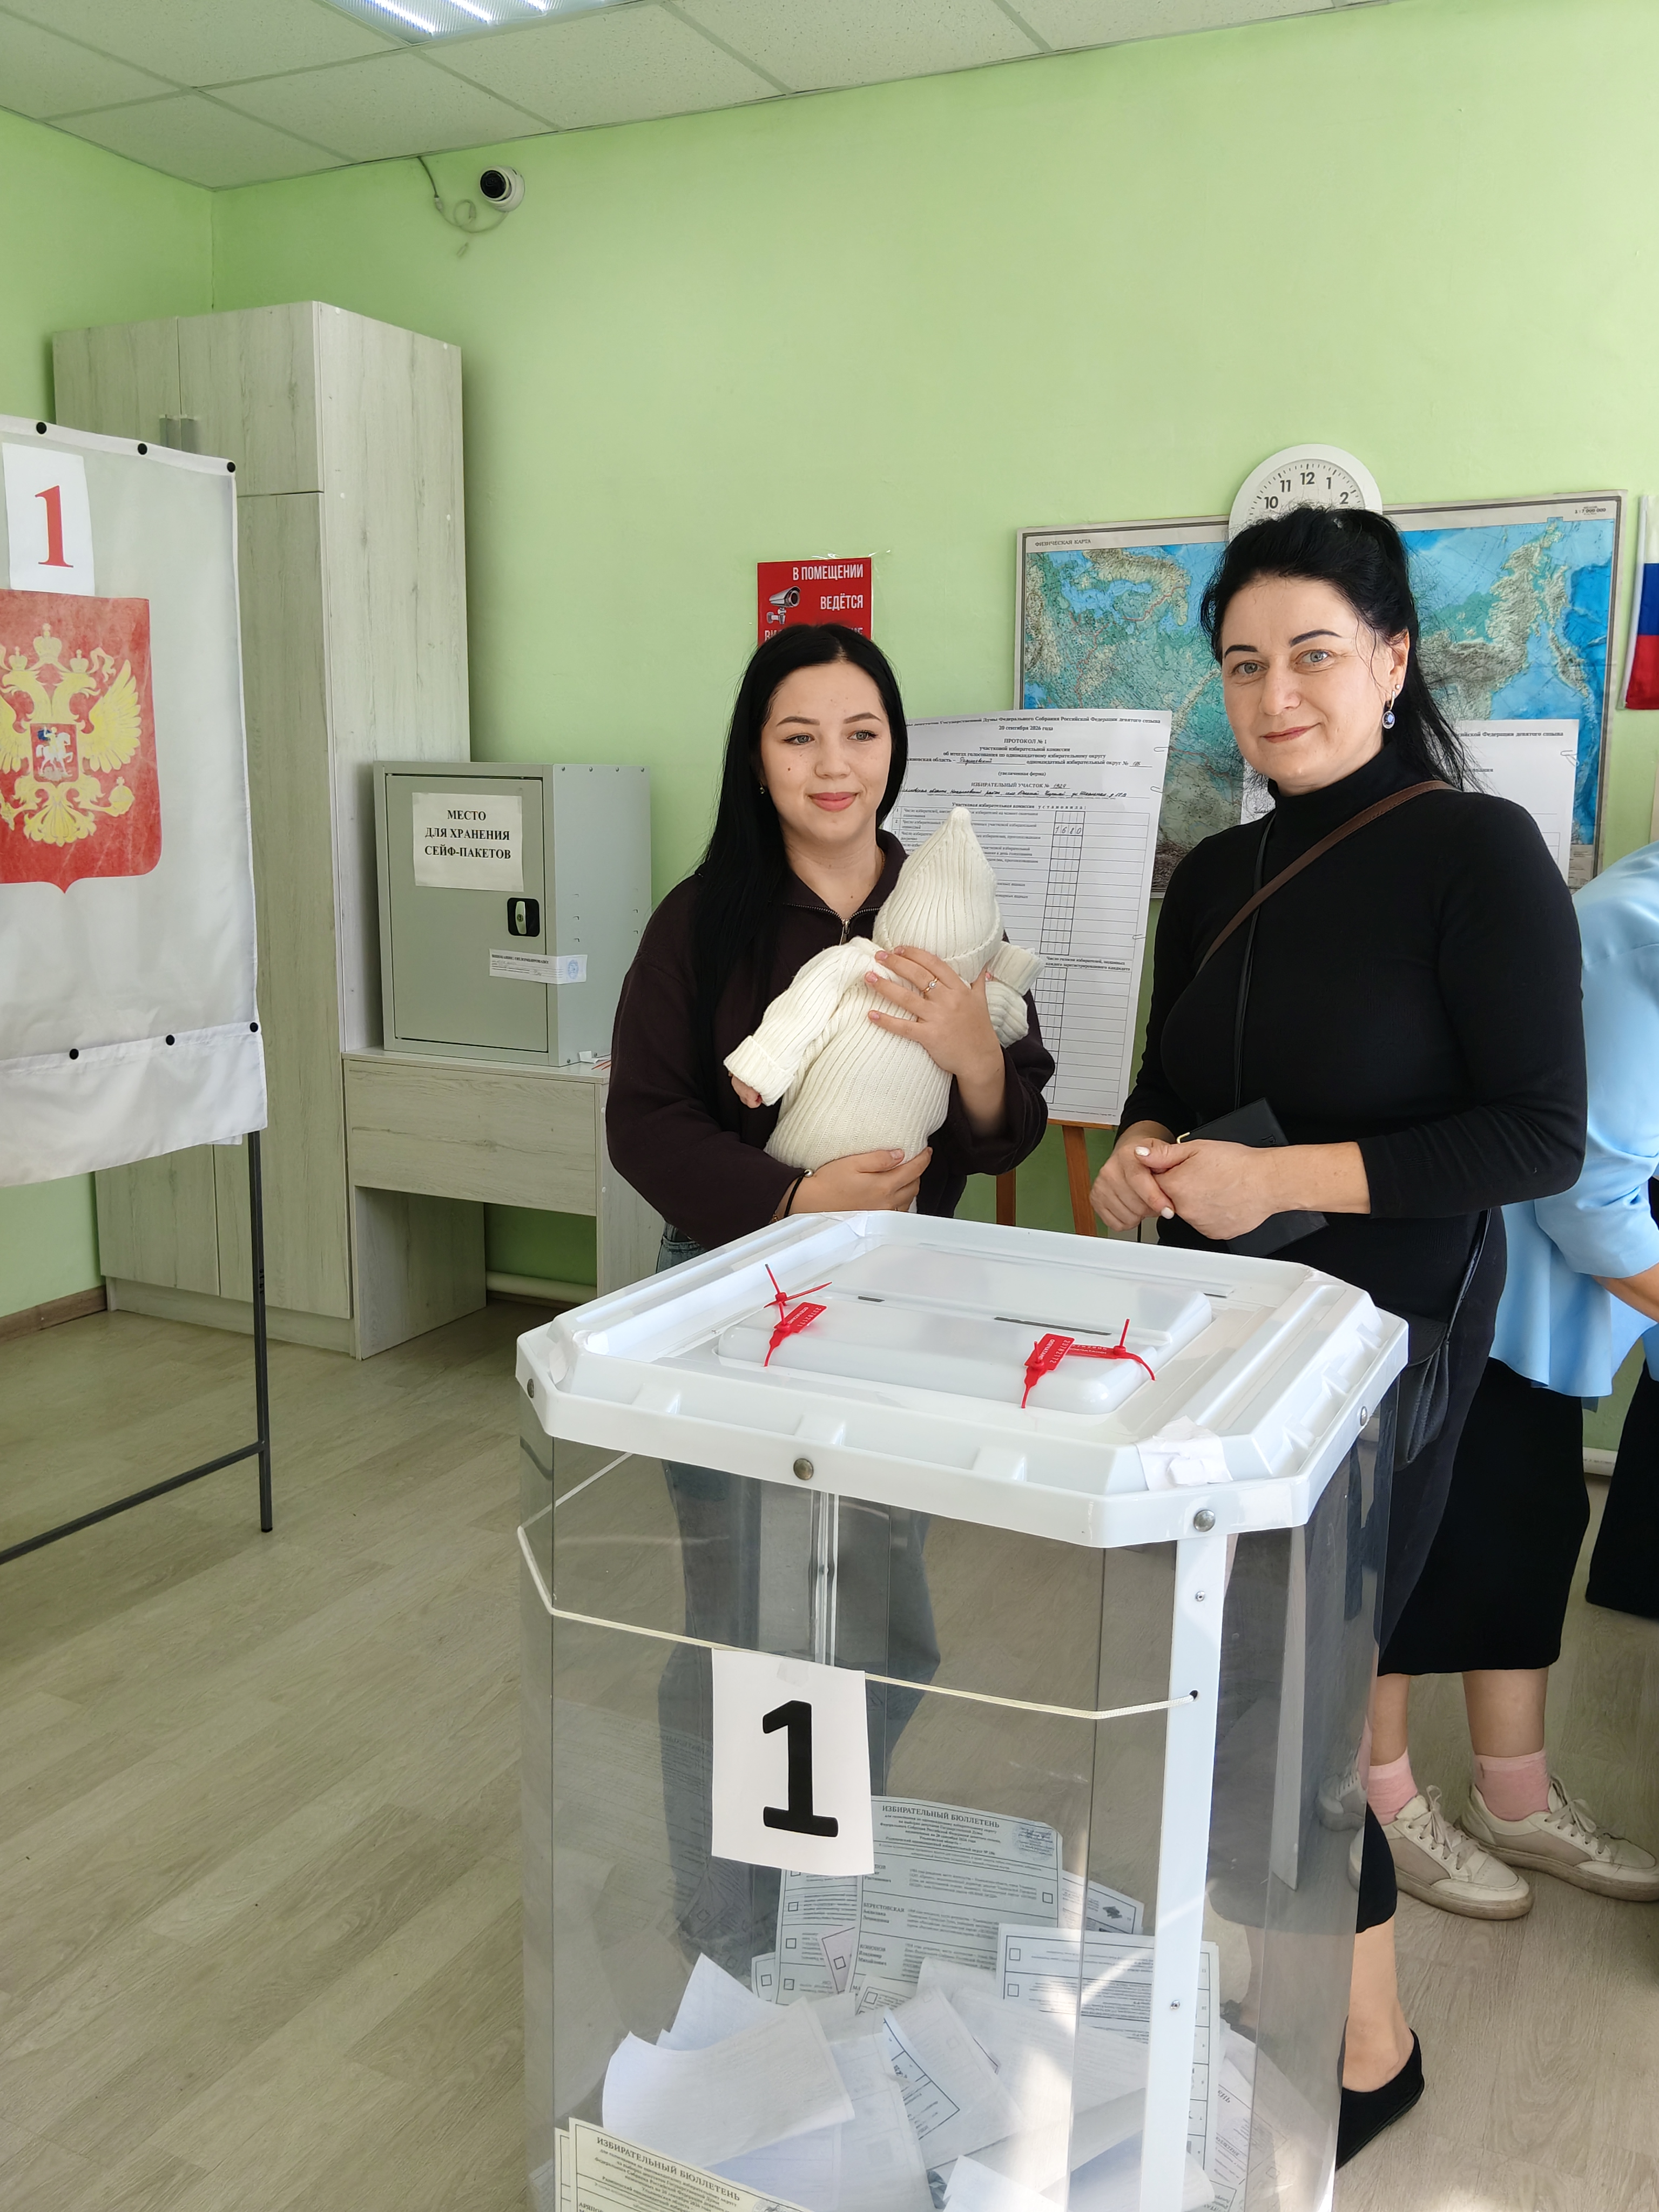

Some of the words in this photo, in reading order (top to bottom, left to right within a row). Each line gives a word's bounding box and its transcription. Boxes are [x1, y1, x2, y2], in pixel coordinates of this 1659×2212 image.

[1300, 471, 1315, 485] 12
[1326, 477, 1332, 489] 1
[1280, 480, 1291, 493] 11
[1264, 496, 1278, 509] 10
[1340, 491, 1349, 505] 2
[35, 485, 73, 568] 1
[793, 567, 799, 581] В
[801, 564, 864, 581] ПОМЕЩЕНИИ
[820, 593, 864, 611] ВЕДЁТСЯ
[447, 810, 487, 821] МЕСТО
[425, 827, 447, 838] ДЛЯ
[450, 829, 510, 841] ХРАНЕНИЯ
[424, 844, 511, 859] СЕЙФ-ПАКЕТОВ
[762, 1700, 838, 1838] 1
[882, 1805, 949, 1819] ИЗБИРАТЕЛЬНЫЙ
[951, 1814, 1000, 1828] БЮЛЛЕТЕНЬ
[597, 2136, 677, 2175] ИЗБИРАТЕЛЬНЫЙ
[680, 2170, 740, 2201] БЮЛЛЕТЕНЬ
